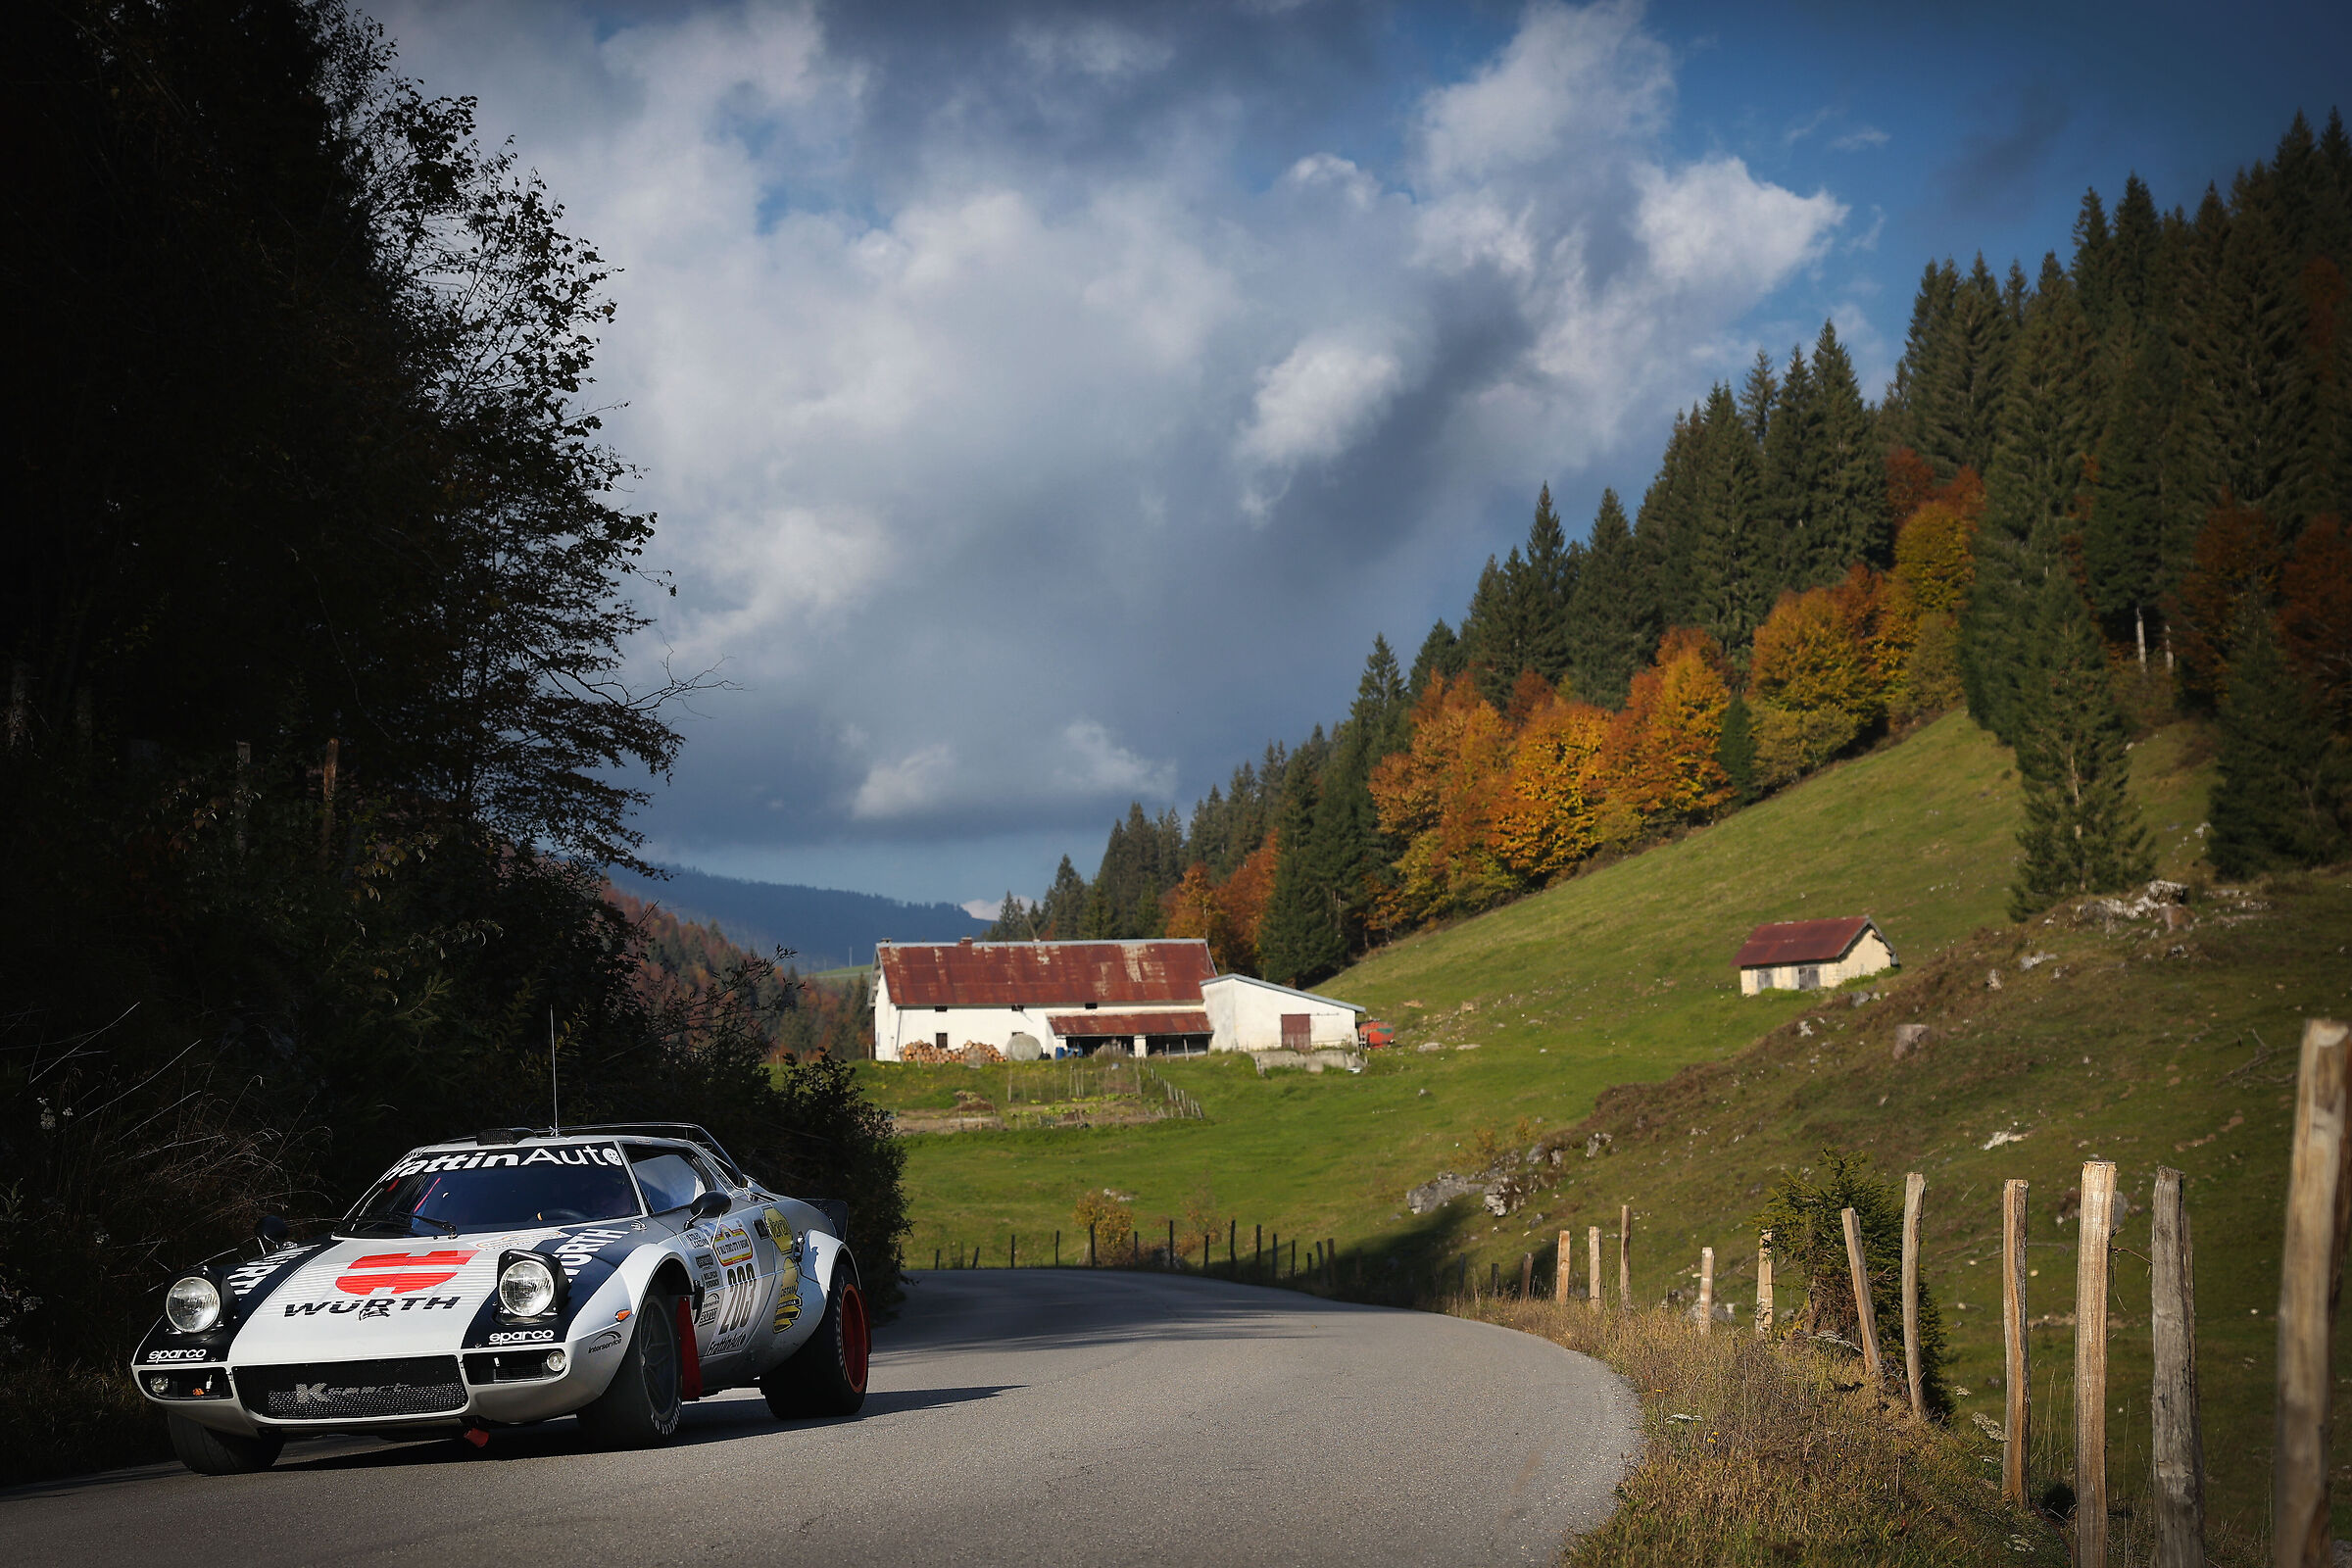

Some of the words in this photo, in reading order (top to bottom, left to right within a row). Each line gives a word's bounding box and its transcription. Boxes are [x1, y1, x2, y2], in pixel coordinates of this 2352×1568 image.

[552, 1229, 629, 1283] ÜRTH
[283, 1296, 461, 1317] WÜRTH
[718, 1263, 757, 1335] 203
[489, 1329, 554, 1346] sparco
[147, 1348, 206, 1364] sparco
